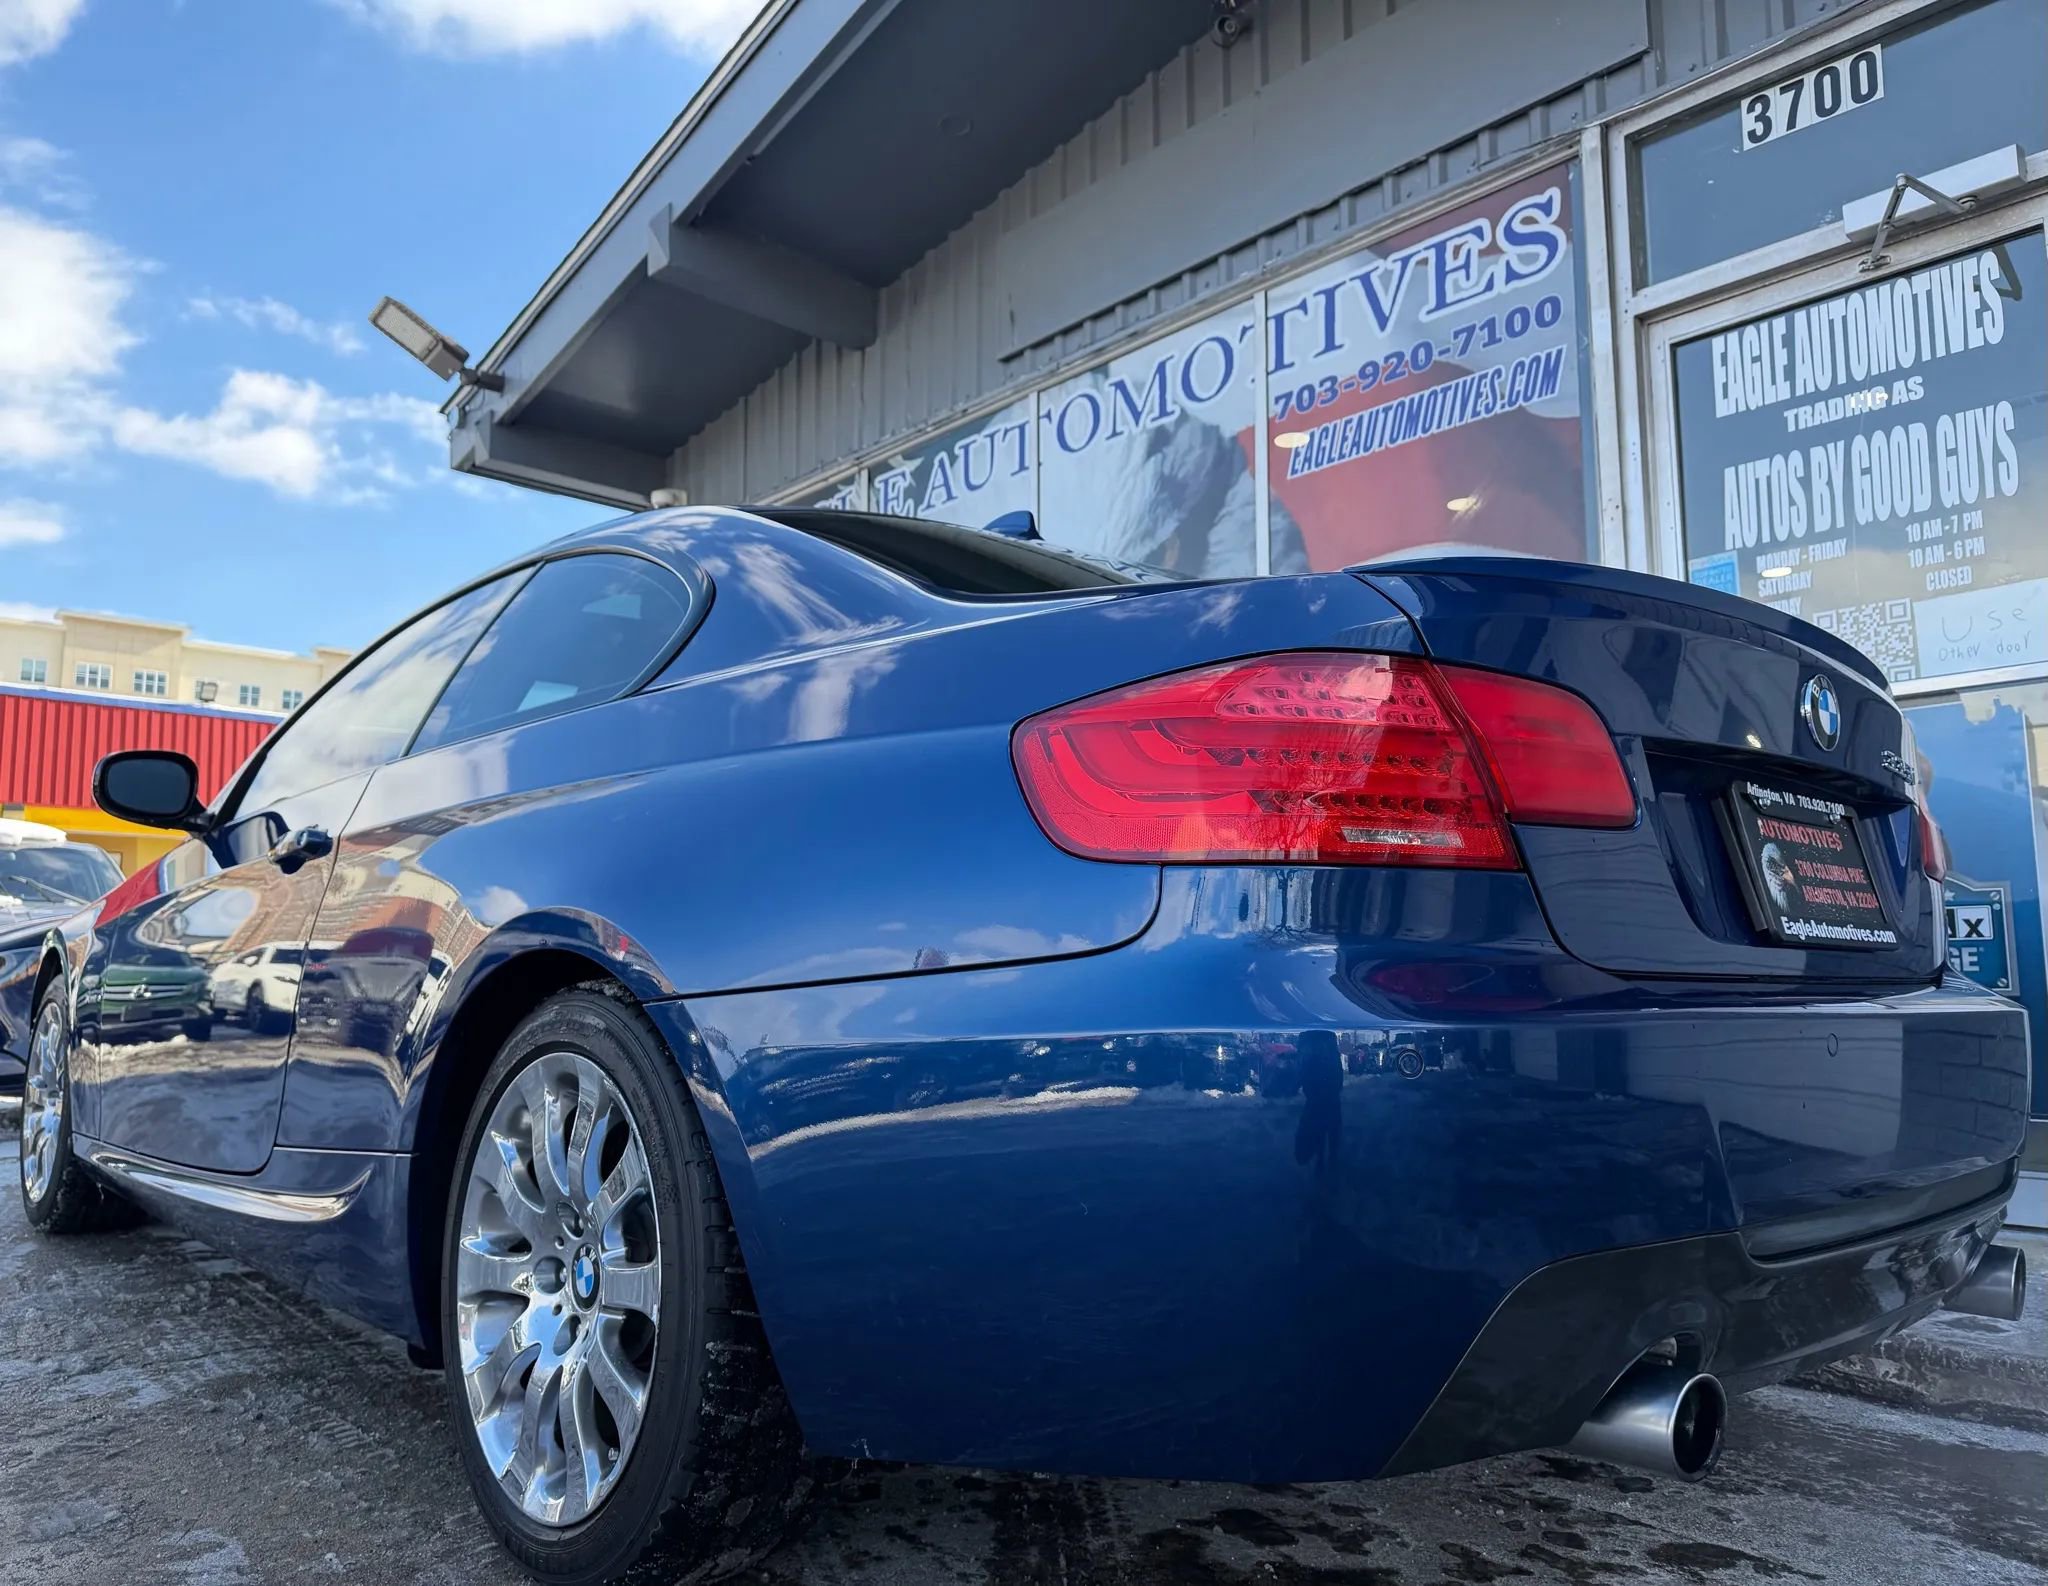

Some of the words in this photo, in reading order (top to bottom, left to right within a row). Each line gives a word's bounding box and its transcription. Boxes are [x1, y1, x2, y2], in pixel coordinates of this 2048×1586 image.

[1746, 51, 1880, 144] 3700
[920, 188, 1565, 515] AUTOMOTIVES
[1711, 316, 1791, 418] EAGLE
[1794, 251, 2005, 397] AUTOMOTIVES
[1275, 295, 1562, 422] 703-920-7100
[1288, 347, 1566, 479] EAGLEAUTOMOTIVES.COM
[1784, 386, 1886, 432] TRADING
[1892, 376, 1925, 406] AS
[1724, 450, 1807, 550] AUTOS
[1810, 440, 1846, 532] BY
[1851, 422, 1932, 526] GOOD
[1936, 401, 2019, 509] GUYS
[1905, 523, 1921, 543] 10
[1923, 518, 1943, 540] AM
[1950, 515, 1958, 534] 7
[1963, 510, 1983, 531] PM
[1756, 548, 1801, 574] MONDAY
[1808, 538, 1848, 563] FRIDAY
[1907, 548, 1923, 568] 10
[1925, 544, 1945, 566] AM
[1954, 540, 1963, 560] 6
[1964, 536, 1985, 557] PM
[1758, 570, 1812, 598] SATURDAY
[1926, 565, 1972, 591] CLOSED
[1747, 781, 1783, 806] Arlington,
[1783, 792, 1796, 806] VA
[1797, 795, 1846, 816] 703.920.7100
[1757, 817, 1844, 851] AUTOMOTIVES
[1780, 916, 1897, 943] EagleAutomotives.com
